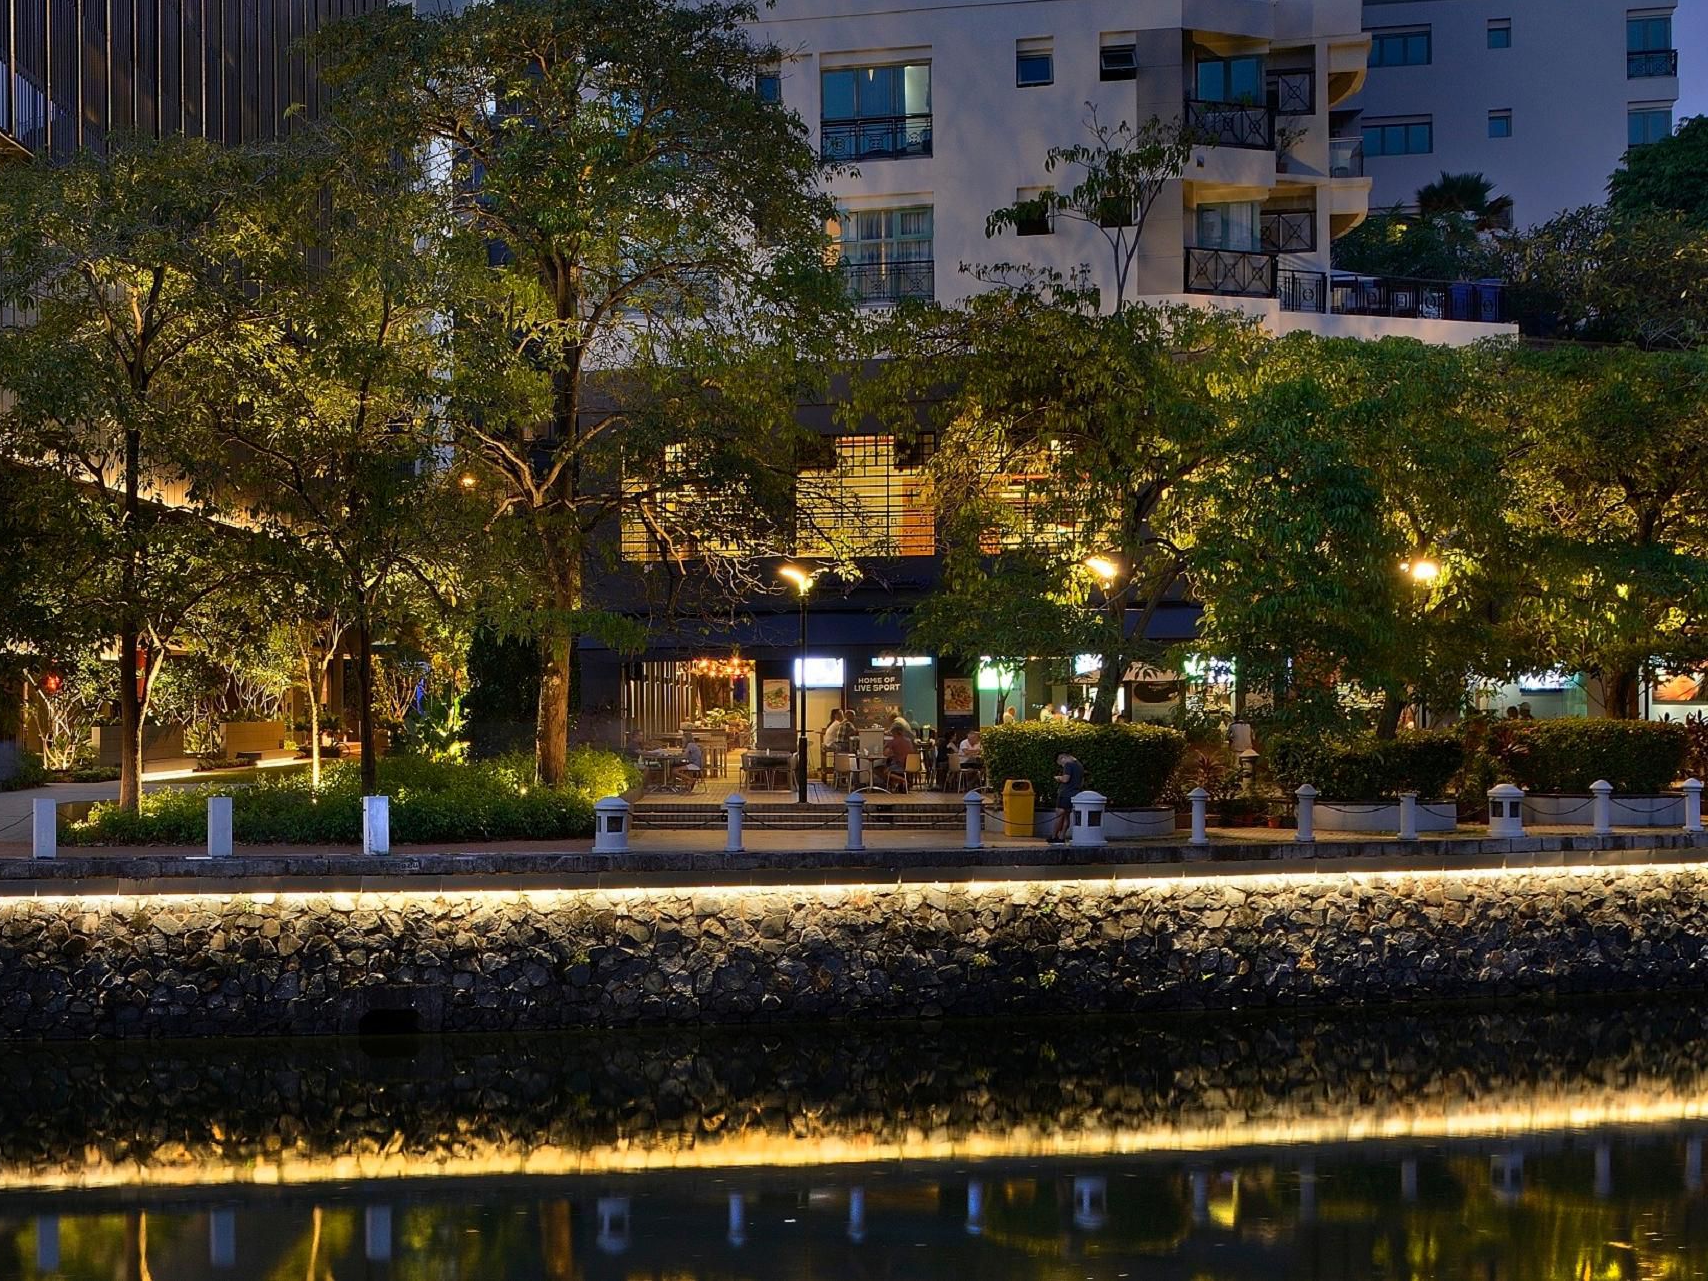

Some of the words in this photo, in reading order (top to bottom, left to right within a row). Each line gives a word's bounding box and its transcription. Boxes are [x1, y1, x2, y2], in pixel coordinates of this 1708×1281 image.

[883, 676, 896, 684] OF
[853, 684, 872, 692] LIVE
[872, 683, 901, 692] SPORT
